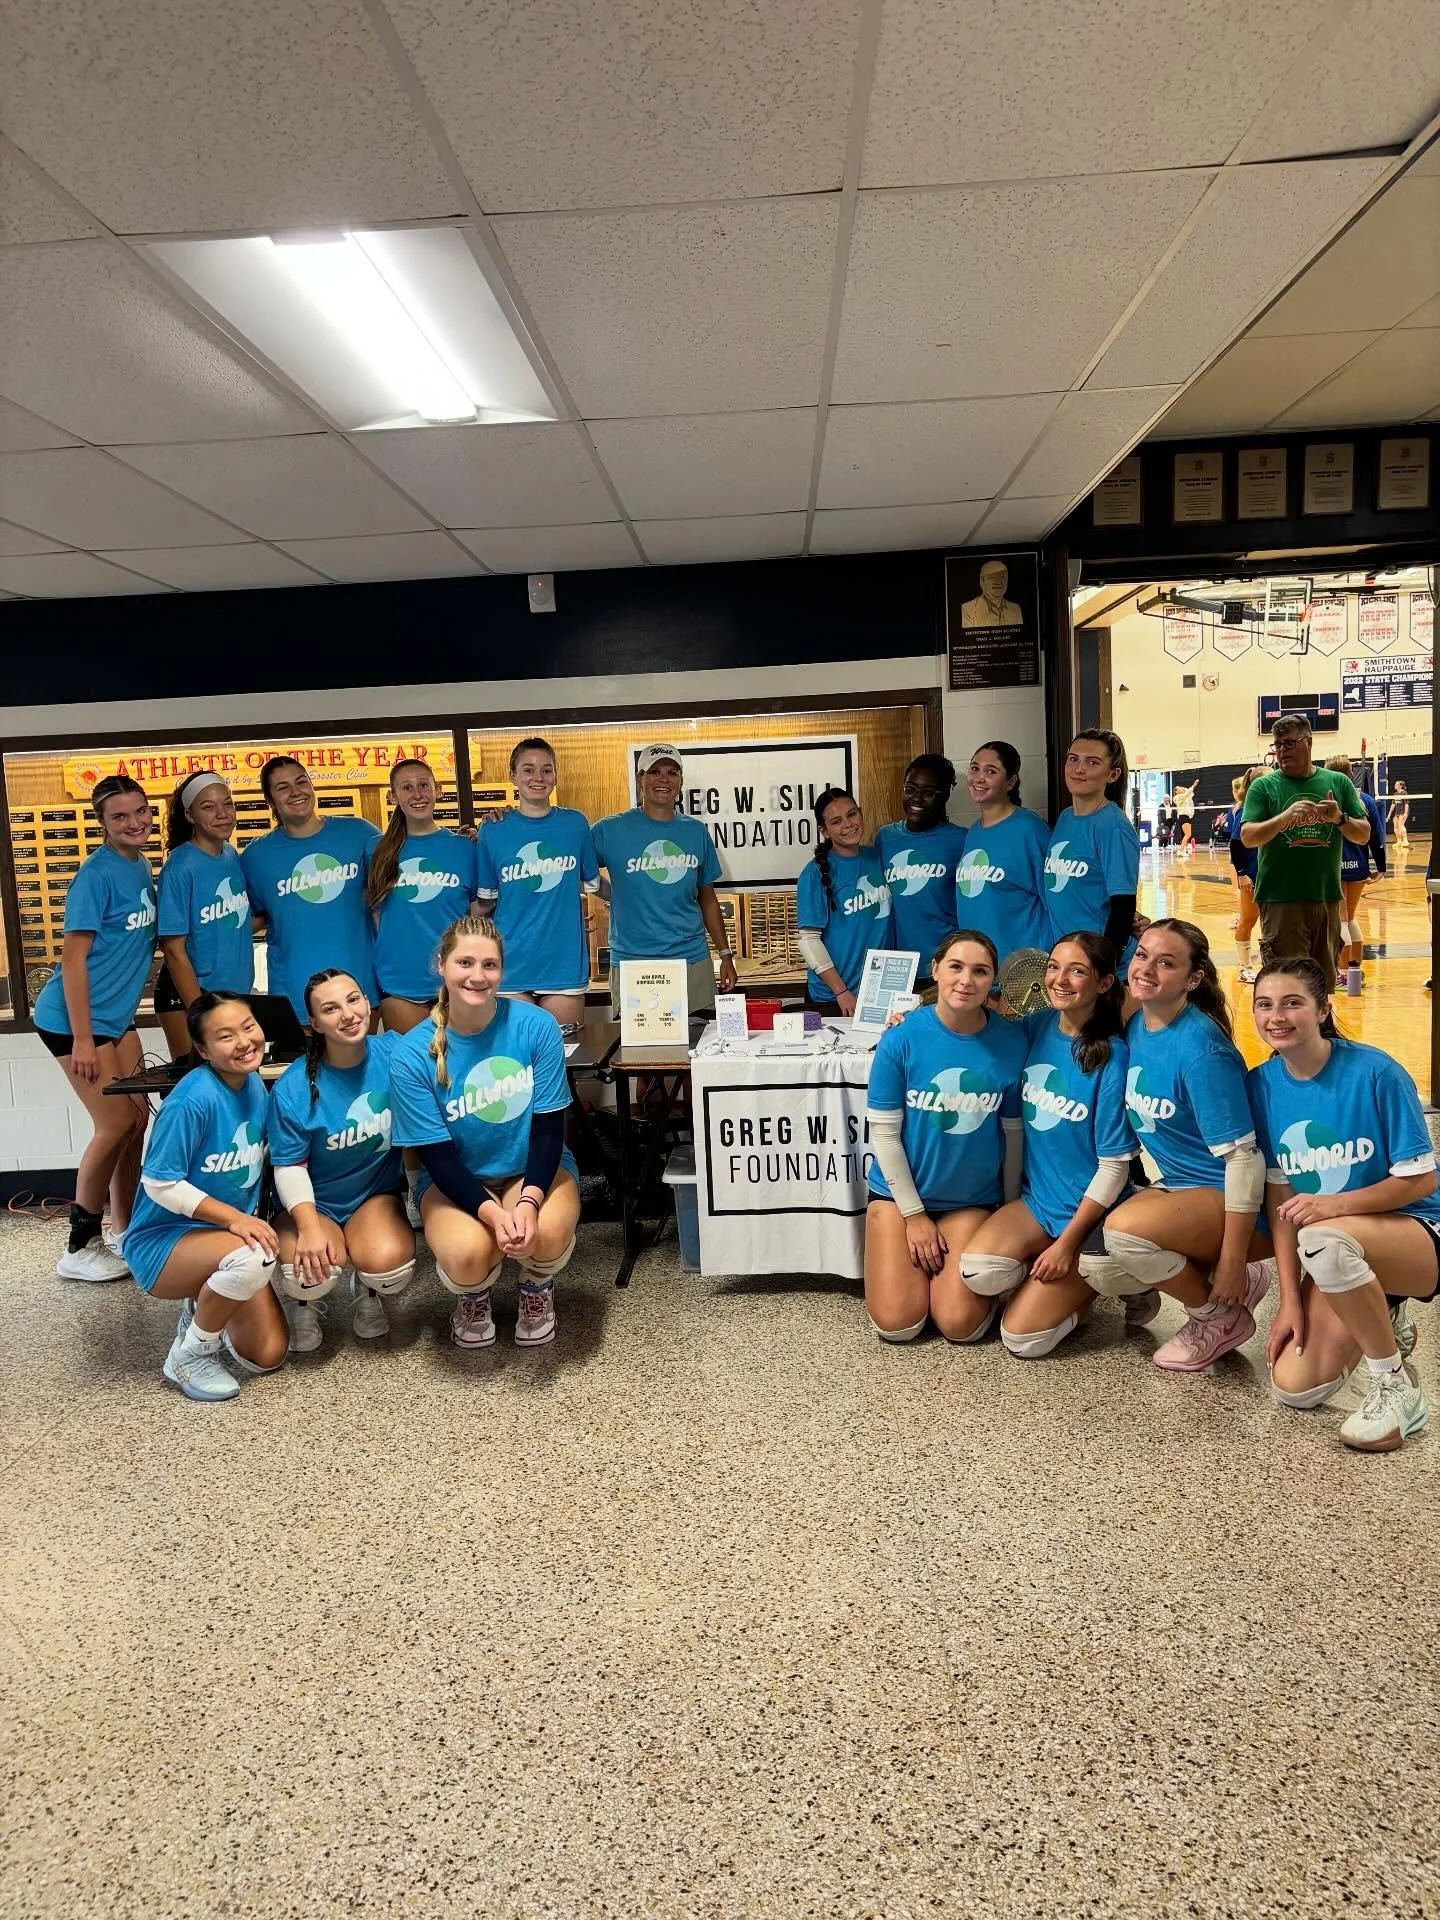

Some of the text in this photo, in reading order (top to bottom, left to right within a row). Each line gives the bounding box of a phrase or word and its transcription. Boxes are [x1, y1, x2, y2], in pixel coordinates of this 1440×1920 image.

[1364, 657, 1416, 667] SMITHTOWN
[1364, 664, 1416, 673] HAUPPAUGE
[1365, 675, 1390, 683] STATE
[116, 752, 237, 781] ATHLETE
[288, 748, 345, 767] THE
[352, 743, 429, 767] YEAR
[346, 767, 369, 781] Club
[734, 786, 765, 814] W.
[501, 855, 577, 884] SILLWORLD
[626, 854, 699, 875] SILLWORLD
[277, 862, 359, 898] SILLWORLD
[719, 1116, 792, 1148] GREG
[807, 1115, 837, 1145] W.
